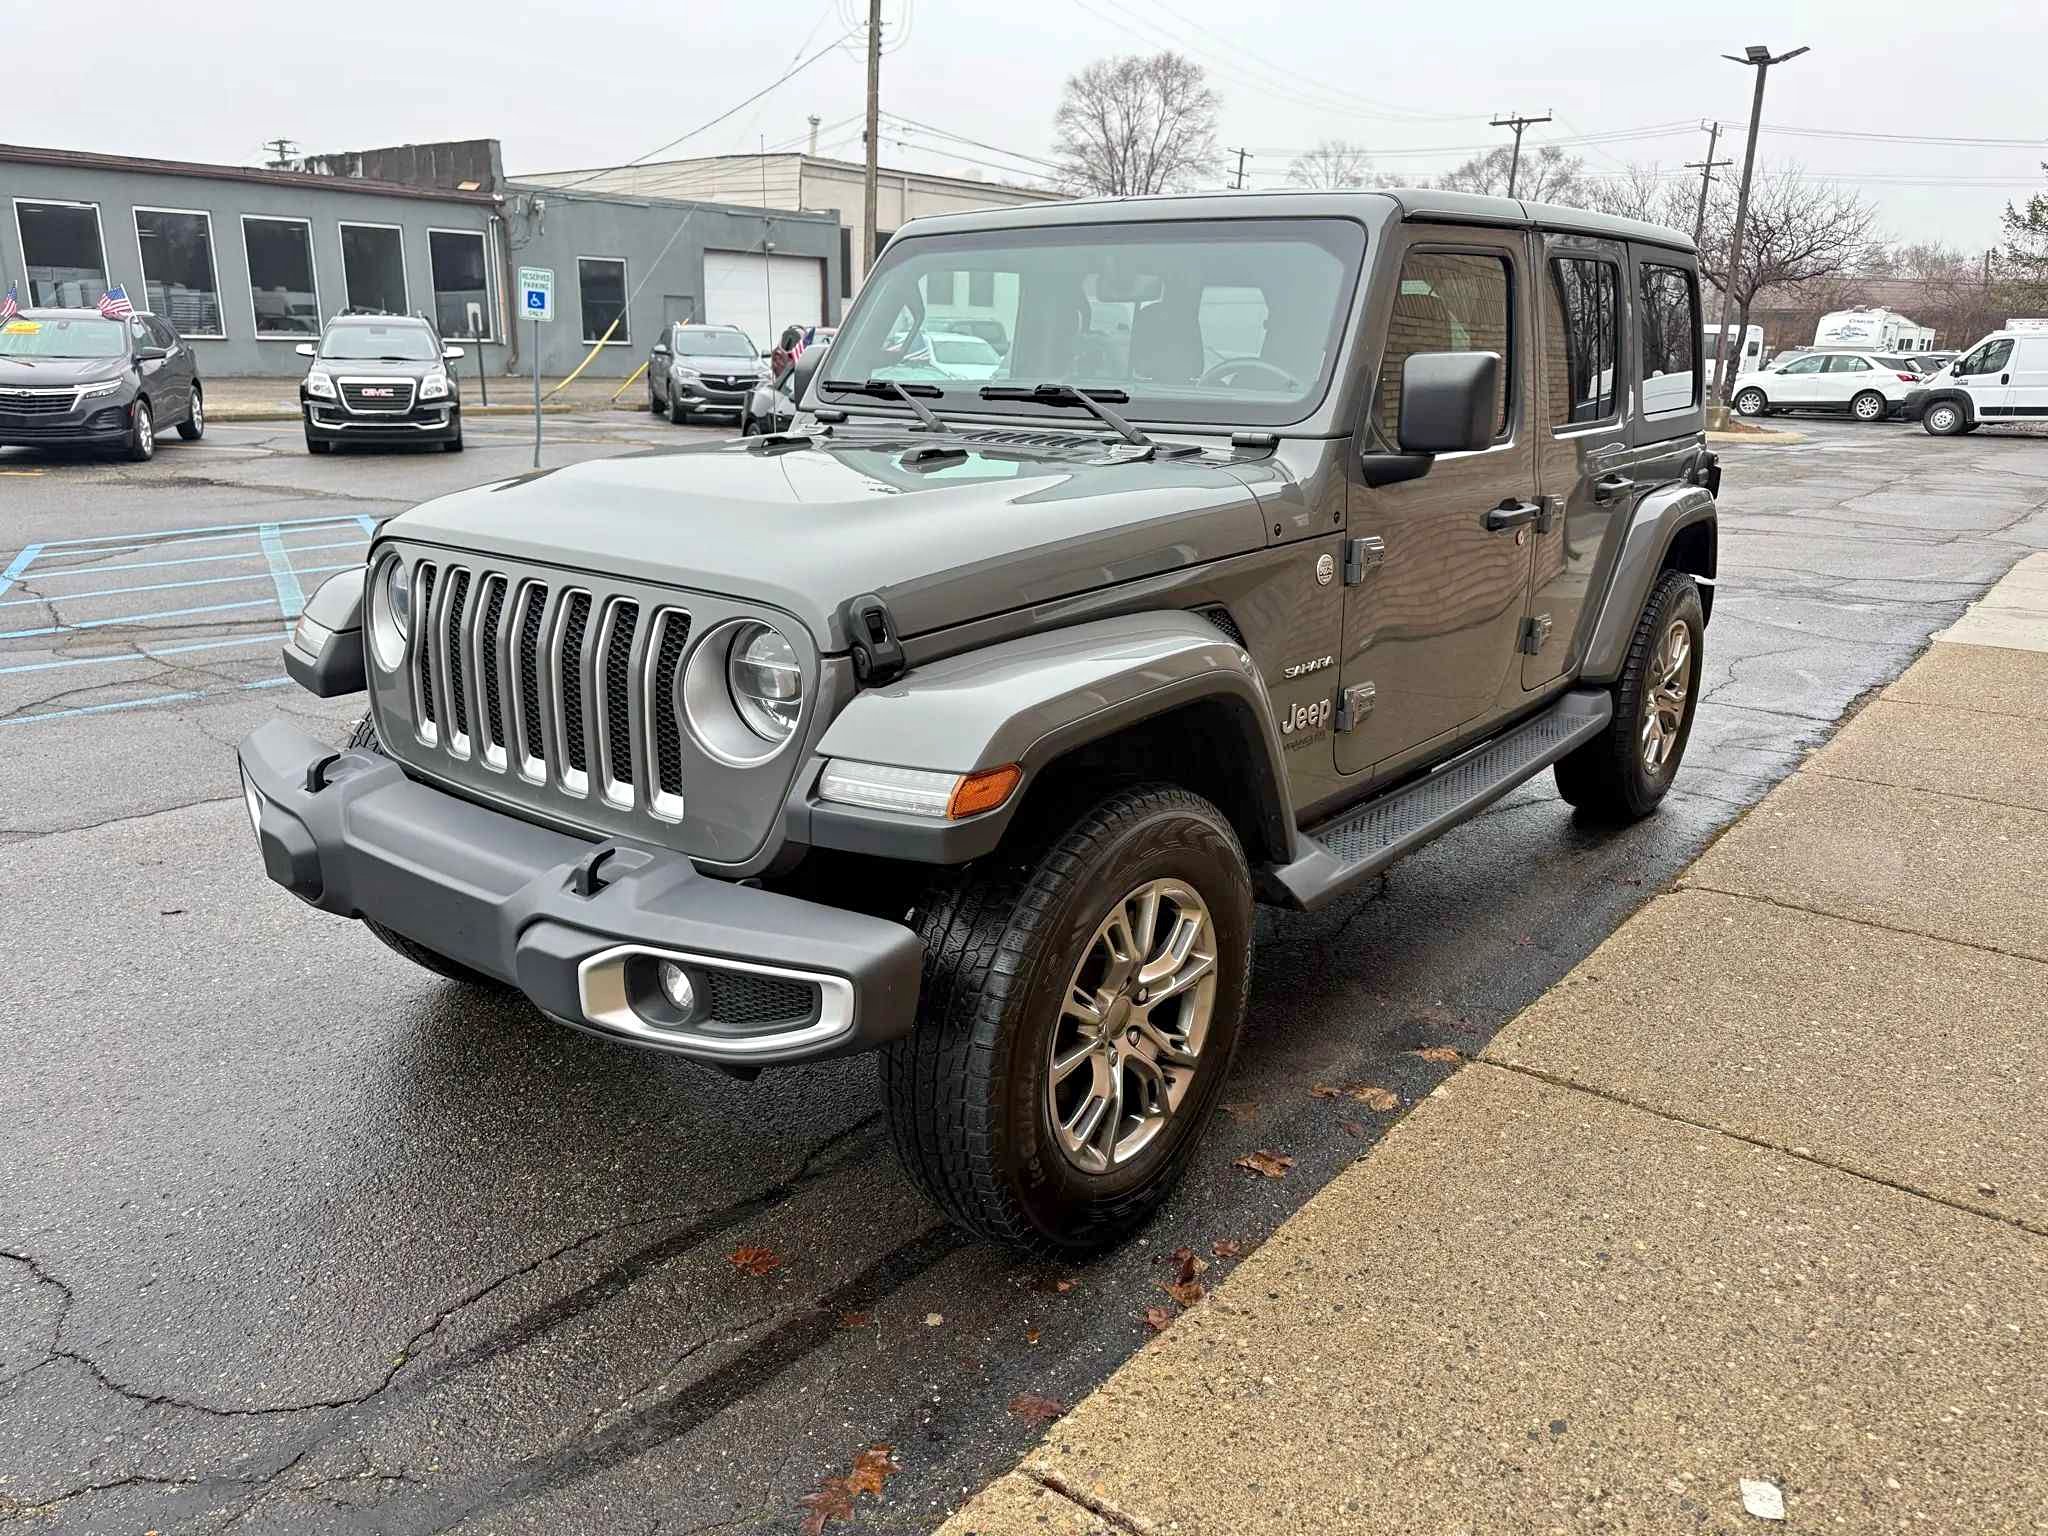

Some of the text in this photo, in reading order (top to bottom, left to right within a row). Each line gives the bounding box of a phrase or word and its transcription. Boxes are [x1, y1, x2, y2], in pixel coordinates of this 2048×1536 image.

[522, 272, 550, 281] RESERVED
[523, 281, 549, 289] PARKING
[361, 388, 394, 396] GMC
[1284, 655, 1334, 679] SAHARA
[1282, 699, 1331, 734] Jeep
